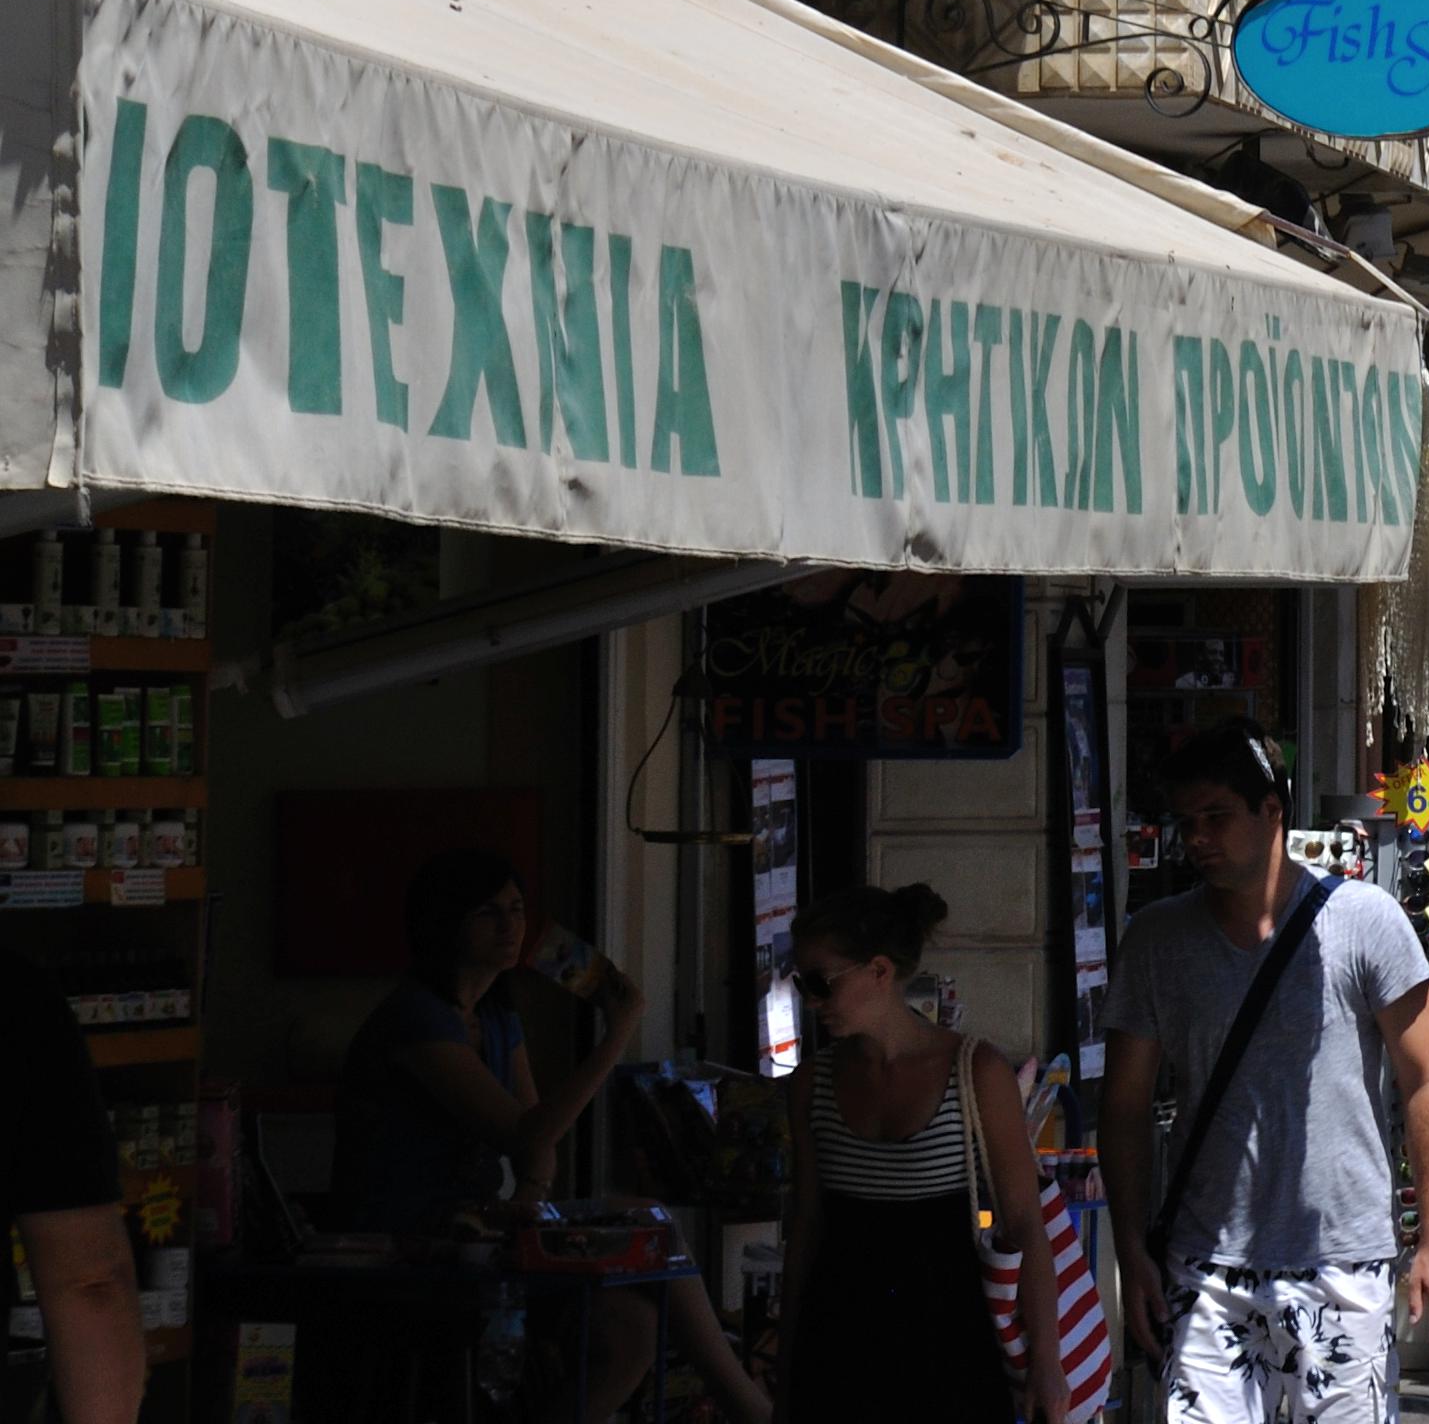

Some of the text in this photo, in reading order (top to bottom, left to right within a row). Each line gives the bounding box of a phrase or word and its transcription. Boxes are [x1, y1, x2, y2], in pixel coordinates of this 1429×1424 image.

[98, 97, 722, 477] ΙΟΤΕΧΝΙΑ
[709, 624, 877, 696] Magic
[711, 694, 1003, 746] FISH SPA
